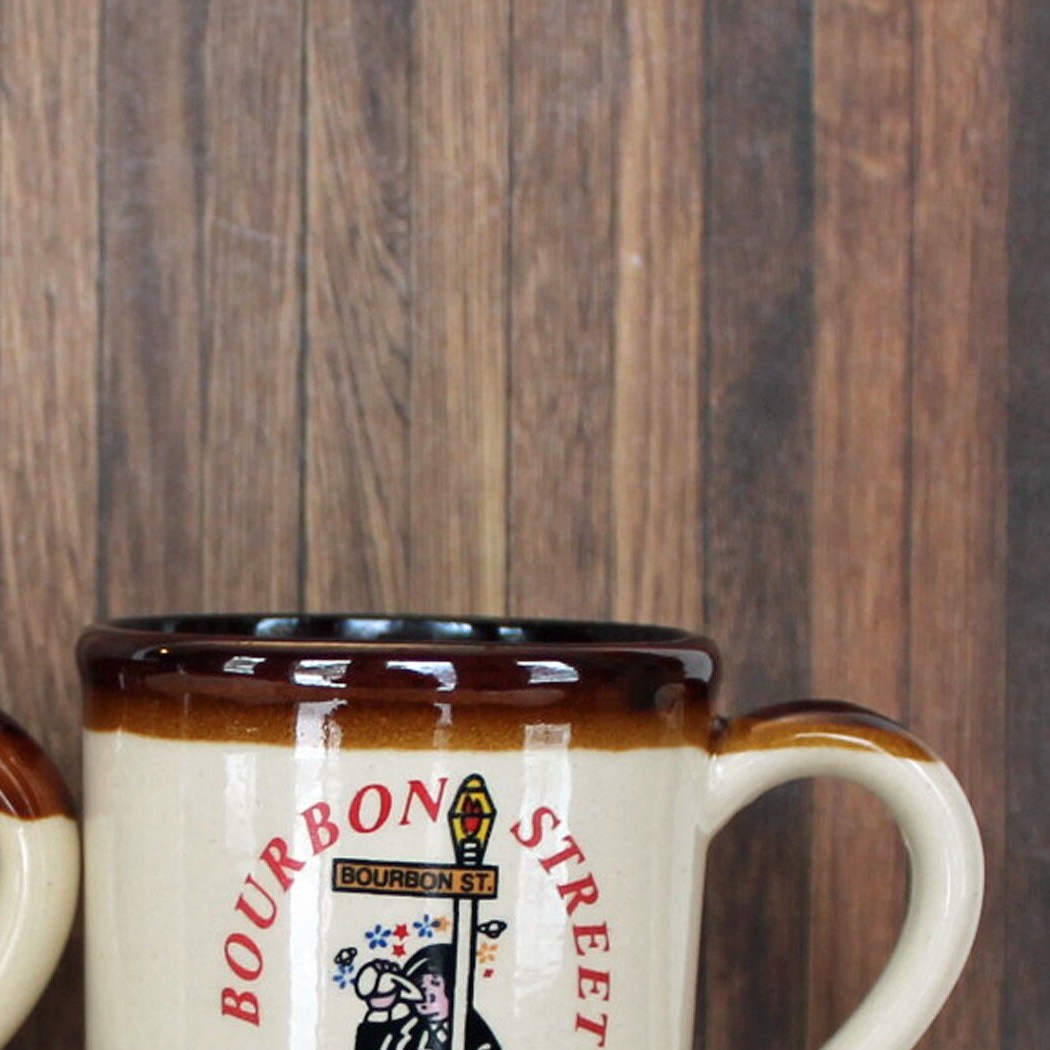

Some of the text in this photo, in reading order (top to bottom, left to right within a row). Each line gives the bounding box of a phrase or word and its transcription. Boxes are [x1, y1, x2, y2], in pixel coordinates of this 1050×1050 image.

[221, 777, 611, 1047] BOURBON STREET
[340, 865, 494, 893] BOURBON ST.
